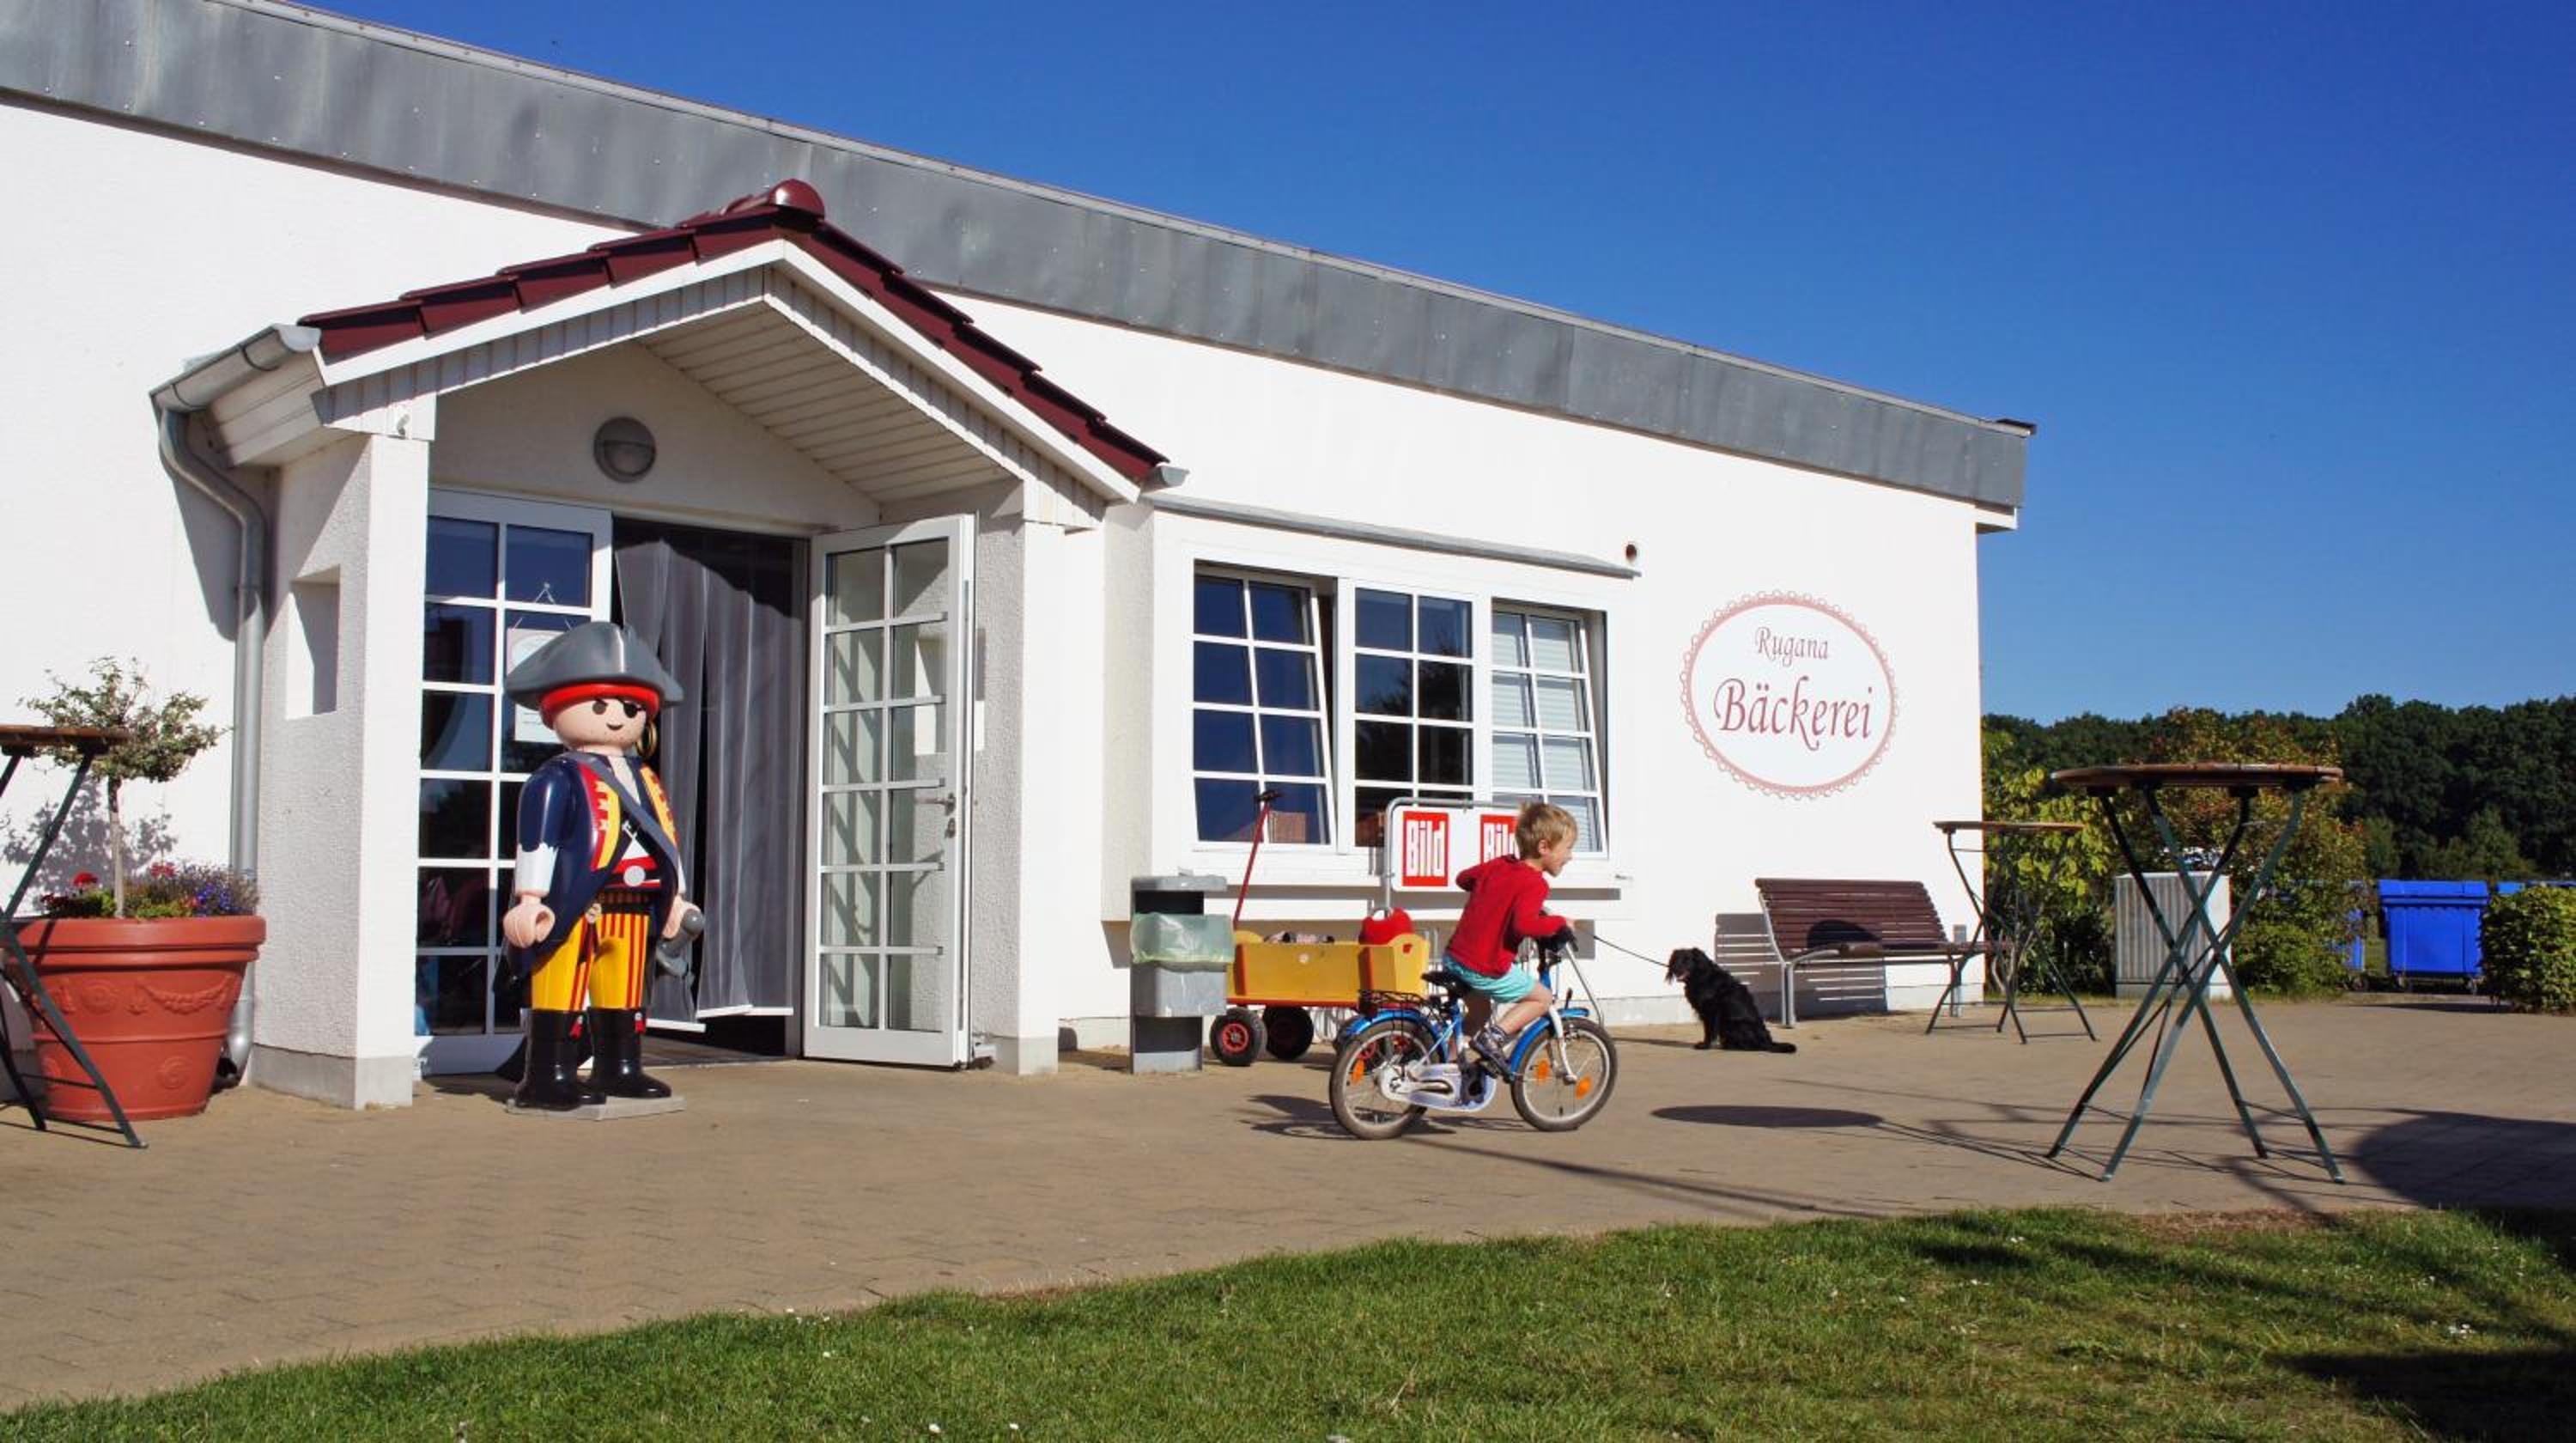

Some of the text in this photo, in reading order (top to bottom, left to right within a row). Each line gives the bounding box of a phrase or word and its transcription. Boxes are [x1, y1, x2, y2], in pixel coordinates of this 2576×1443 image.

[1755, 625, 1829, 667] Rugana
[1714, 676, 1873, 752] Bäckerei
[1406, 820, 1446, 877] Bild
